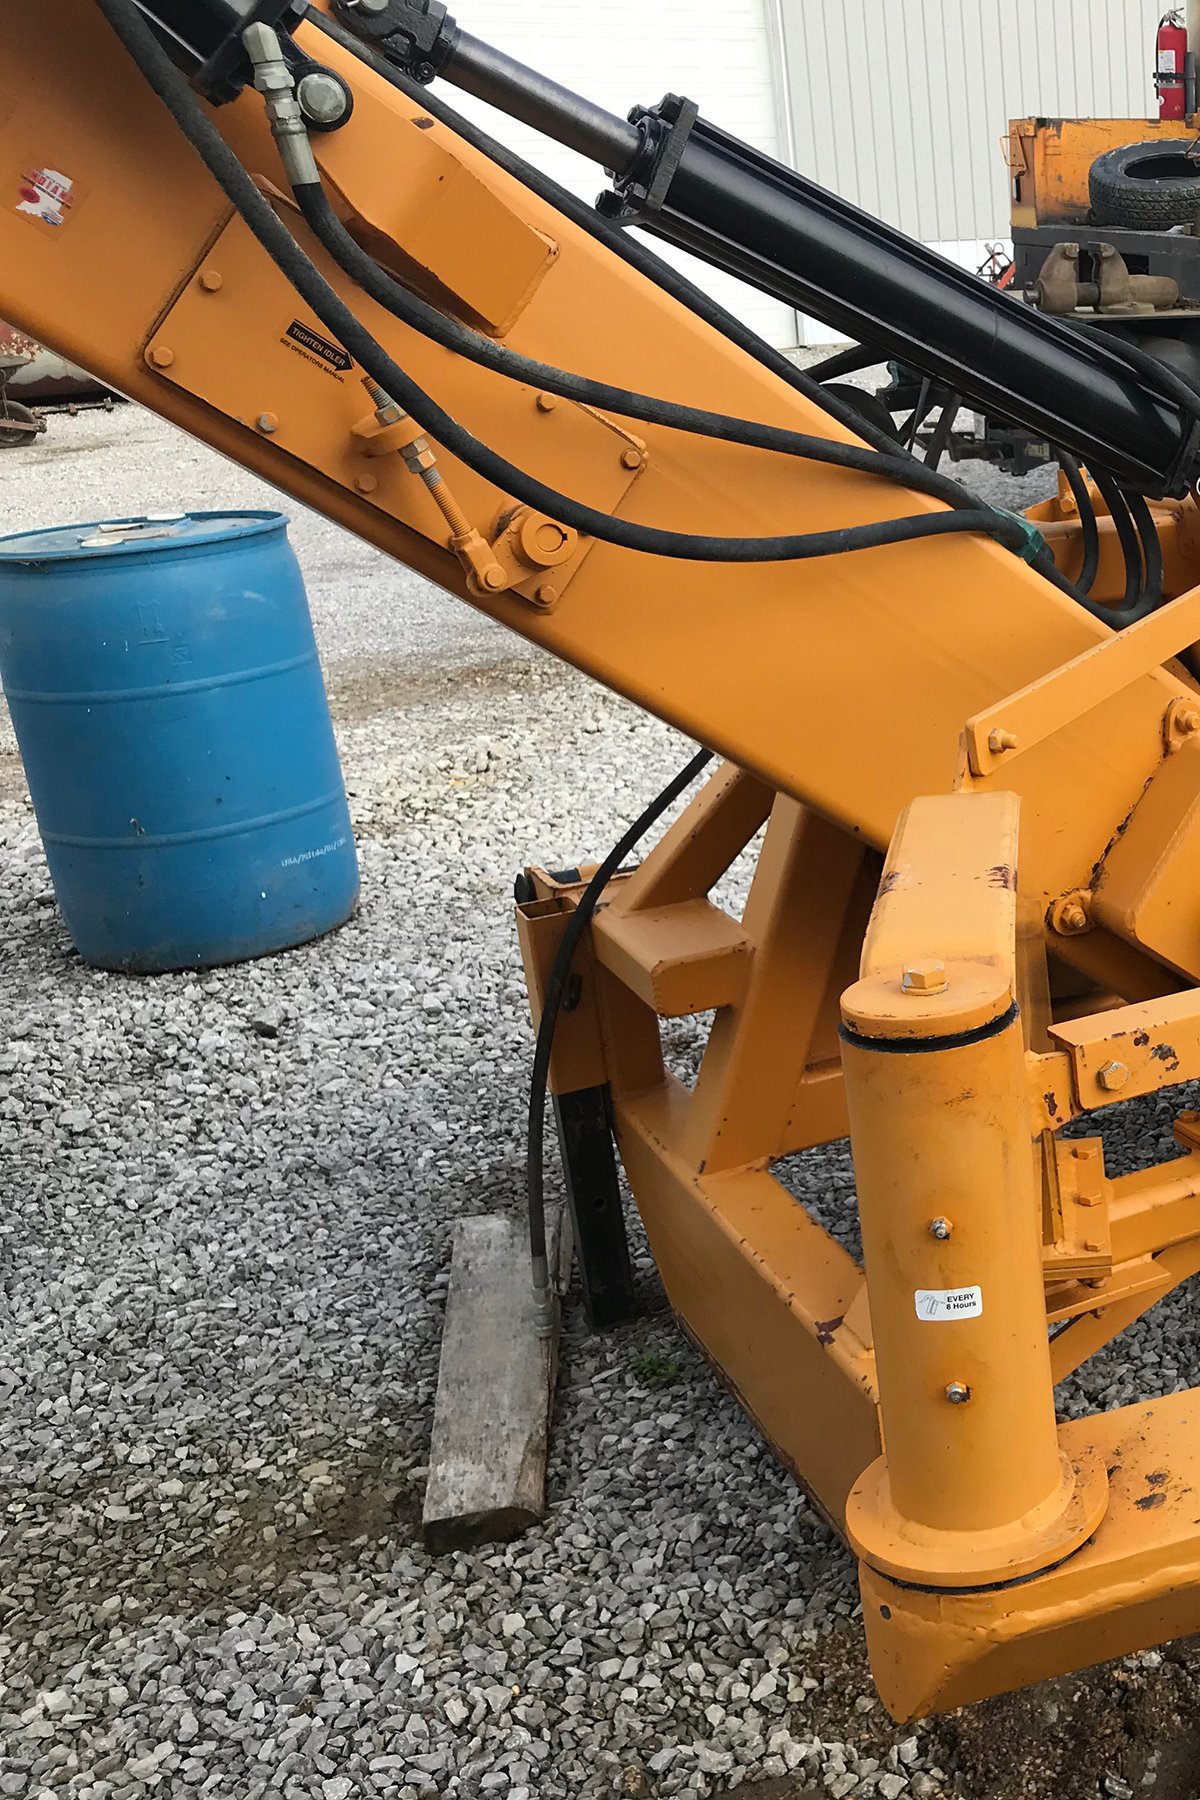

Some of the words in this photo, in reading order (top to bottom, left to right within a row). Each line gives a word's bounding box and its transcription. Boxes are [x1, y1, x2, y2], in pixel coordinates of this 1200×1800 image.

[292, 327, 325, 352] TIGHTEN
[323, 348, 346, 367] IDLER
[291, 345, 324, 369] OPERATORS
[323, 365, 345, 384] MANUAL
[947, 1293, 975, 1303] EVERY
[953, 1301, 976, 1309] Hours
